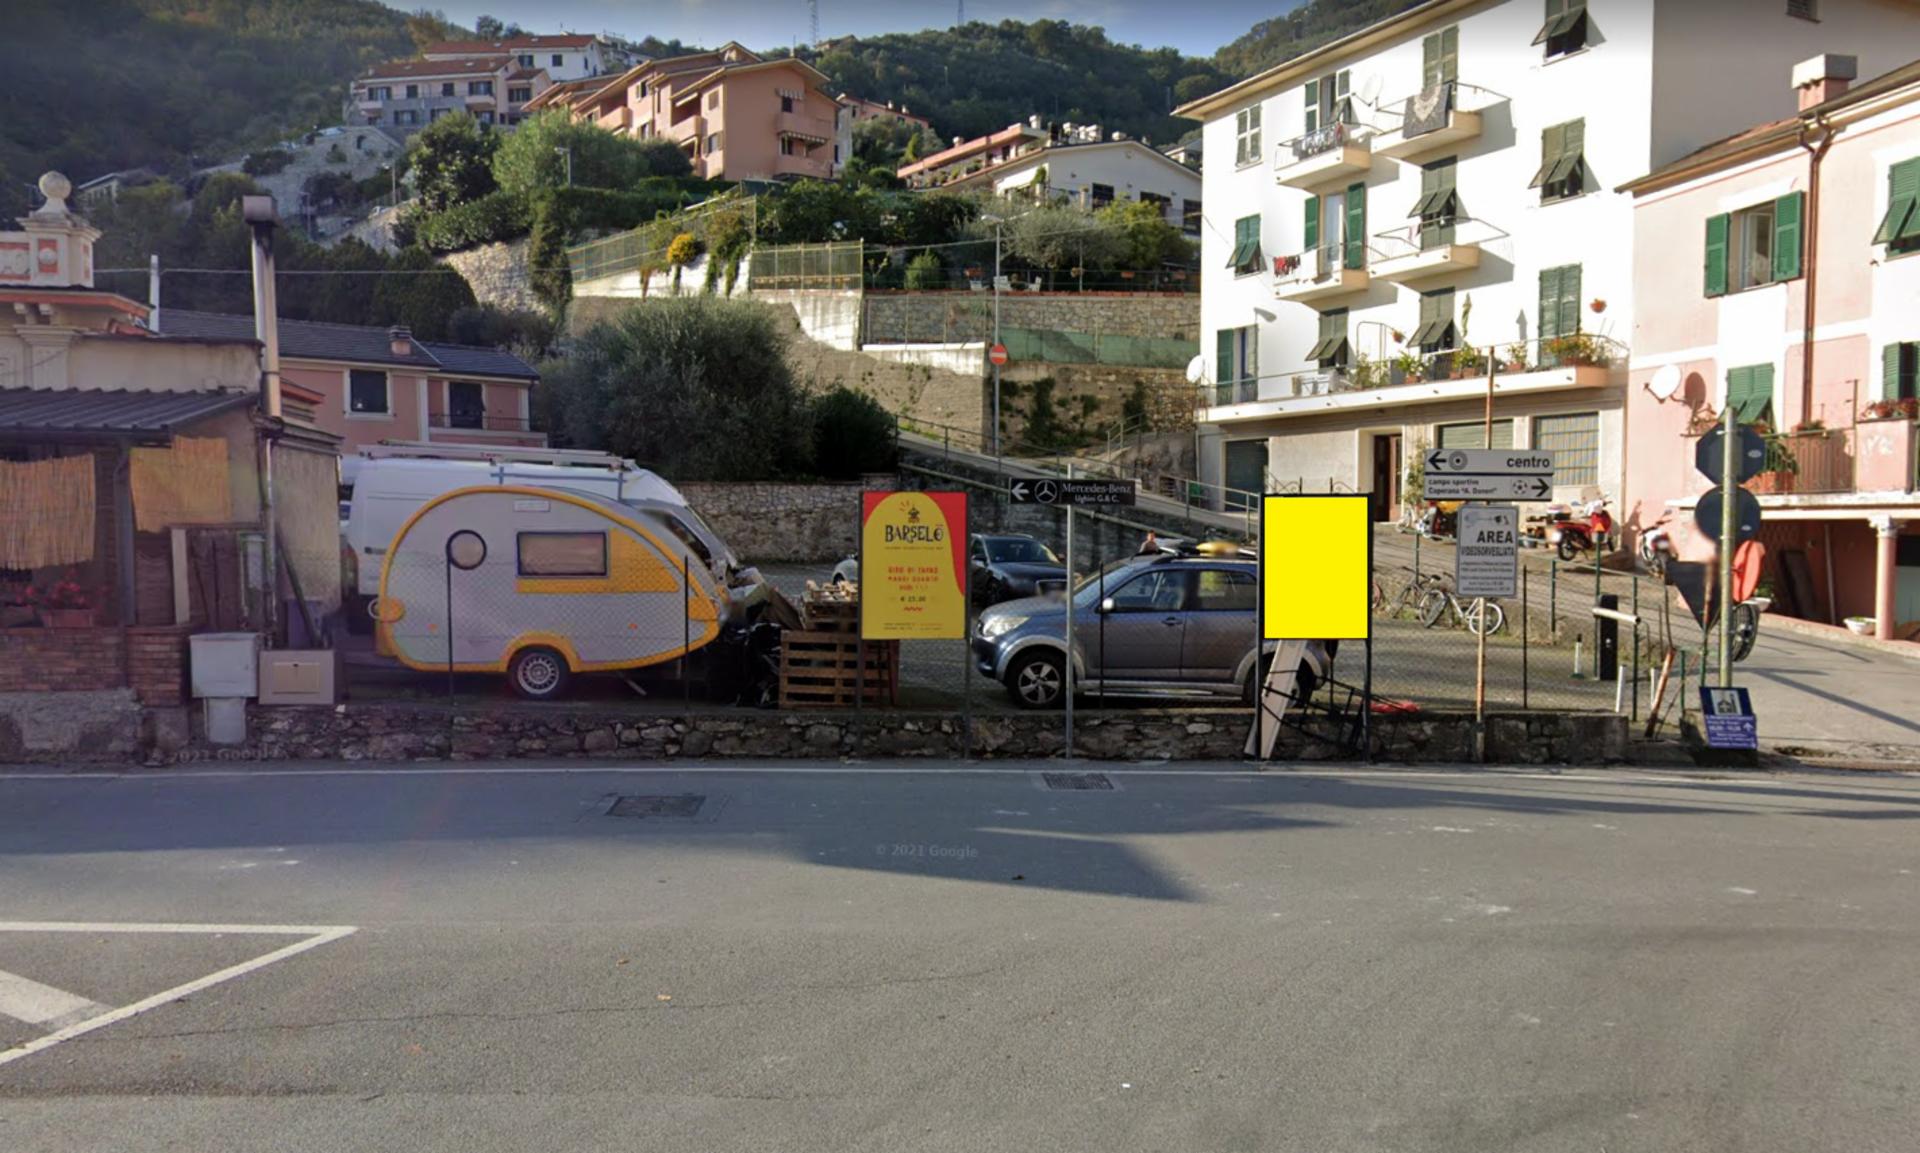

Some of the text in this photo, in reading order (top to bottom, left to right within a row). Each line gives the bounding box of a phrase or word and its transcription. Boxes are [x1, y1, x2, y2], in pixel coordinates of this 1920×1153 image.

[1507, 456, 1550, 468] centro
[1062, 482, 1132, 494] Mercedes-Benz
[1428, 478, 1479, 487] campo sportivo
[1476, 530, 1514, 543] AREA
